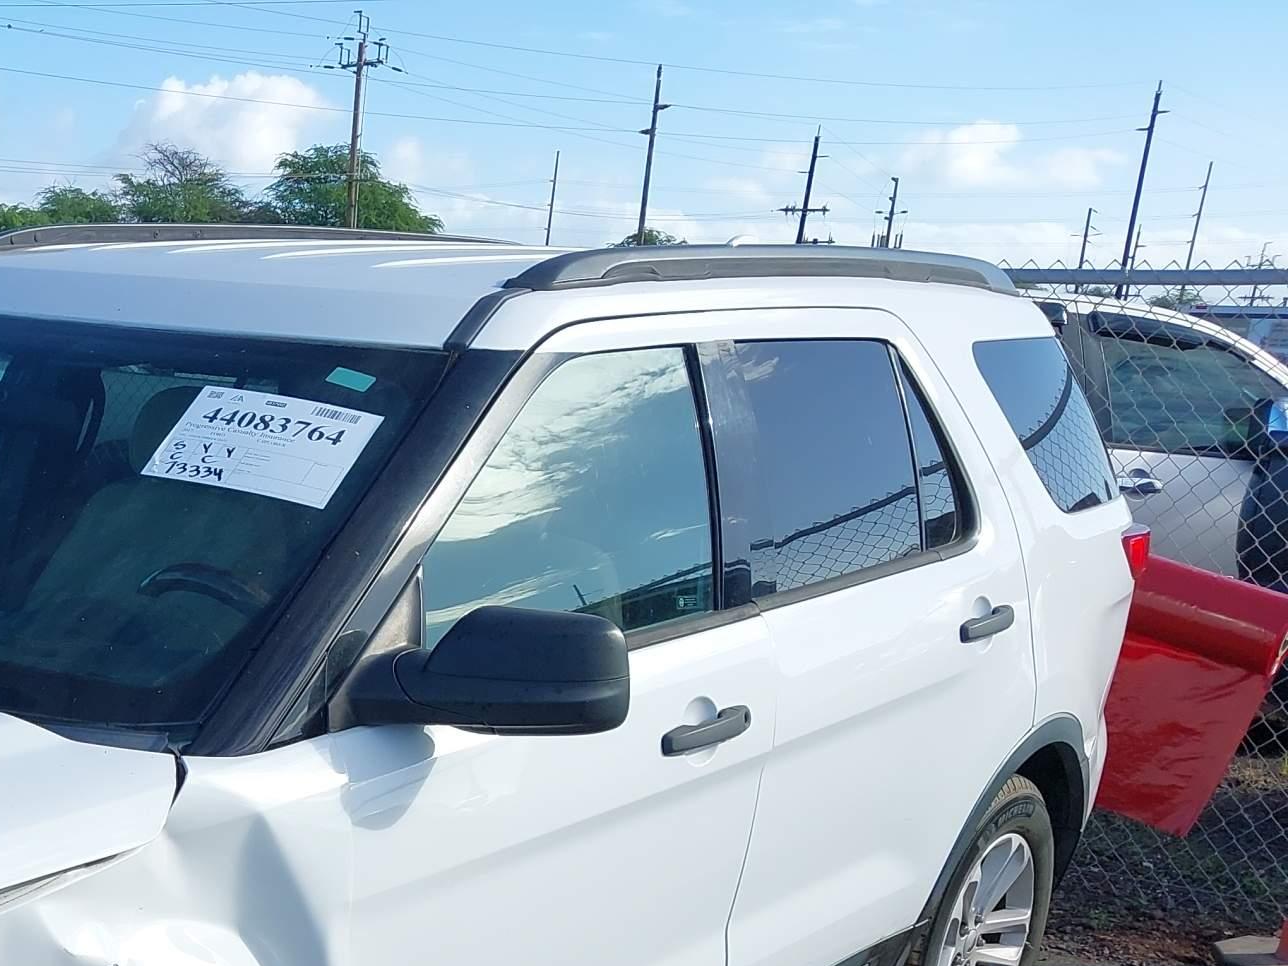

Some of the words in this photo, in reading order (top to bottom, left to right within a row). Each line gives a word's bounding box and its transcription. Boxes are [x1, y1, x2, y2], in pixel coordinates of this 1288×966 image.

[185, 421, 226, 433] Progressive
[202, 407, 347, 446] 44083764
[164, 461, 224, 482] 73334
